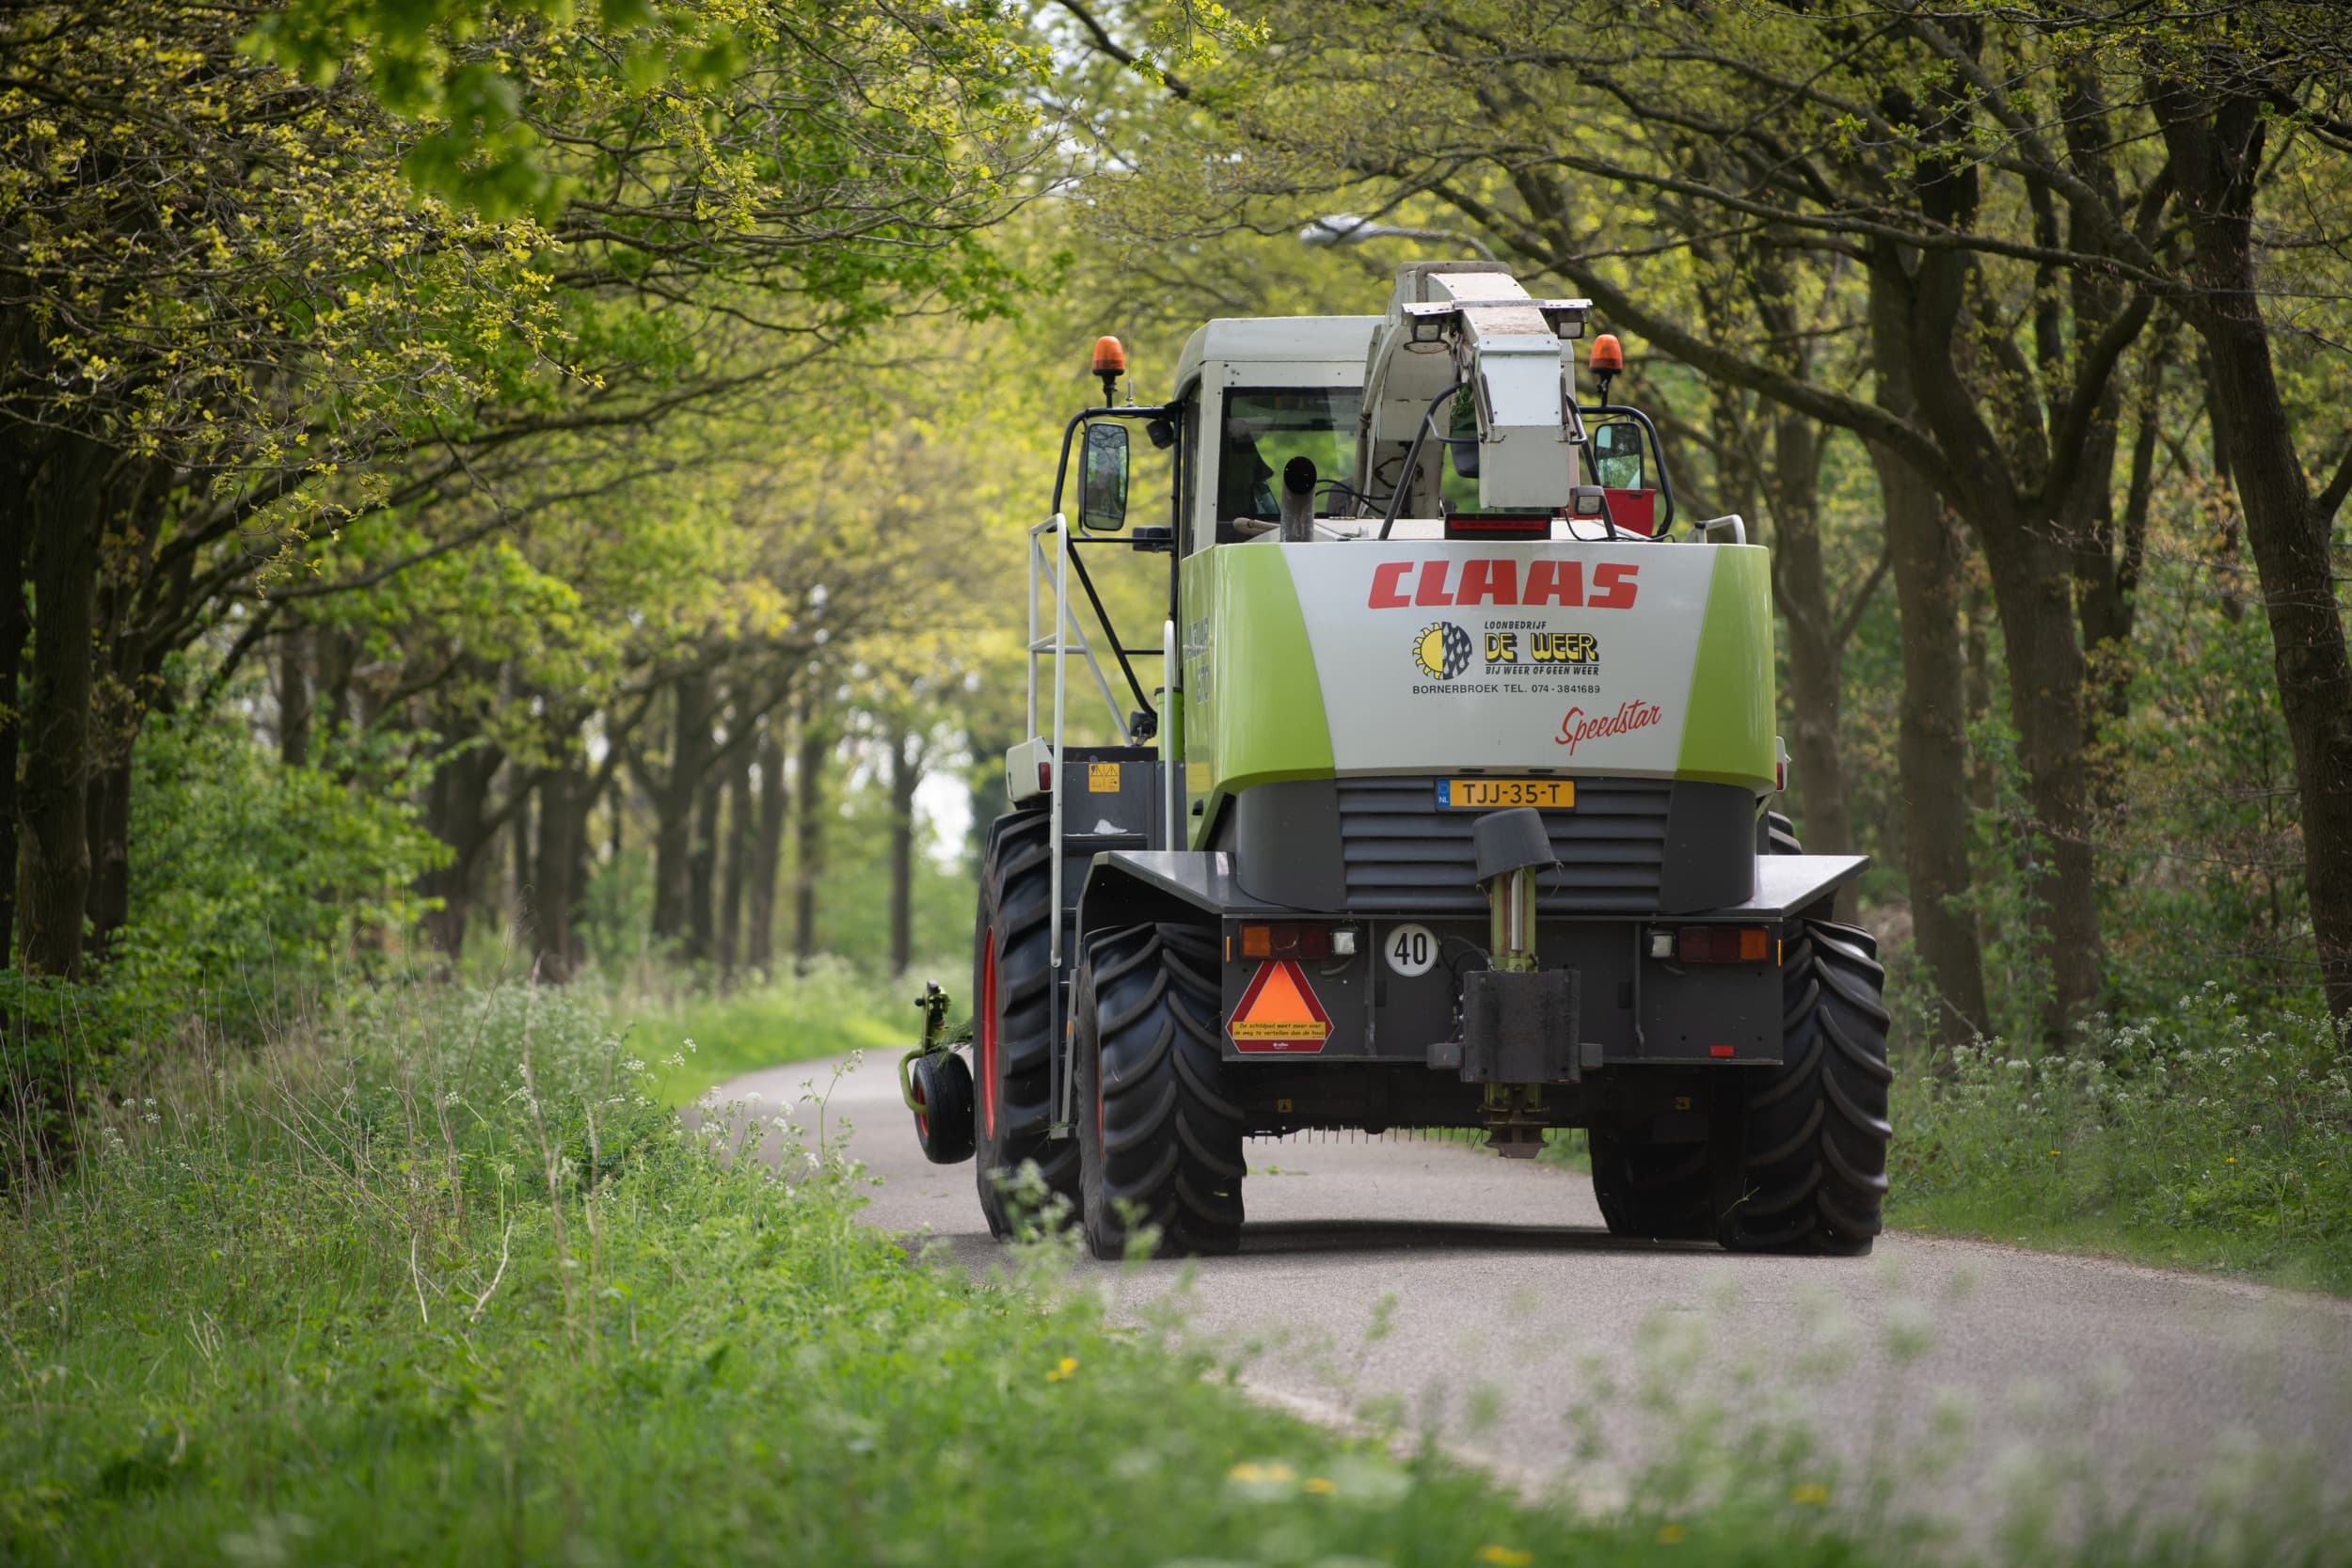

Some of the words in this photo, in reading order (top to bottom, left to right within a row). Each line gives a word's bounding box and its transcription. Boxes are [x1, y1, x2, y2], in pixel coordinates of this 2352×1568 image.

[1368, 560, 1640, 610] CLAAS
[1485, 621, 1548, 630] LOONBEDRIJF
[1485, 632, 1518, 663] DE
[1531, 632, 1599, 663] WEER
[1486, 666, 1501, 675] BIJ
[1503, 666, 1530, 675] WEER
[1533, 666, 1544, 675] OF
[1546, 666, 1570, 676] GEEN
[1573, 667, 1599, 676] WEER
[1412, 684, 1499, 694] BORNERBROEK
[1503, 684, 1528, 693] TEL.
[1555, 700, 1662, 756] Speedstar
[1438, 796, 1450, 804] NL
[1462, 784, 1561, 804] TJJ-35-T
[1394, 933, 1427, 965] 40
